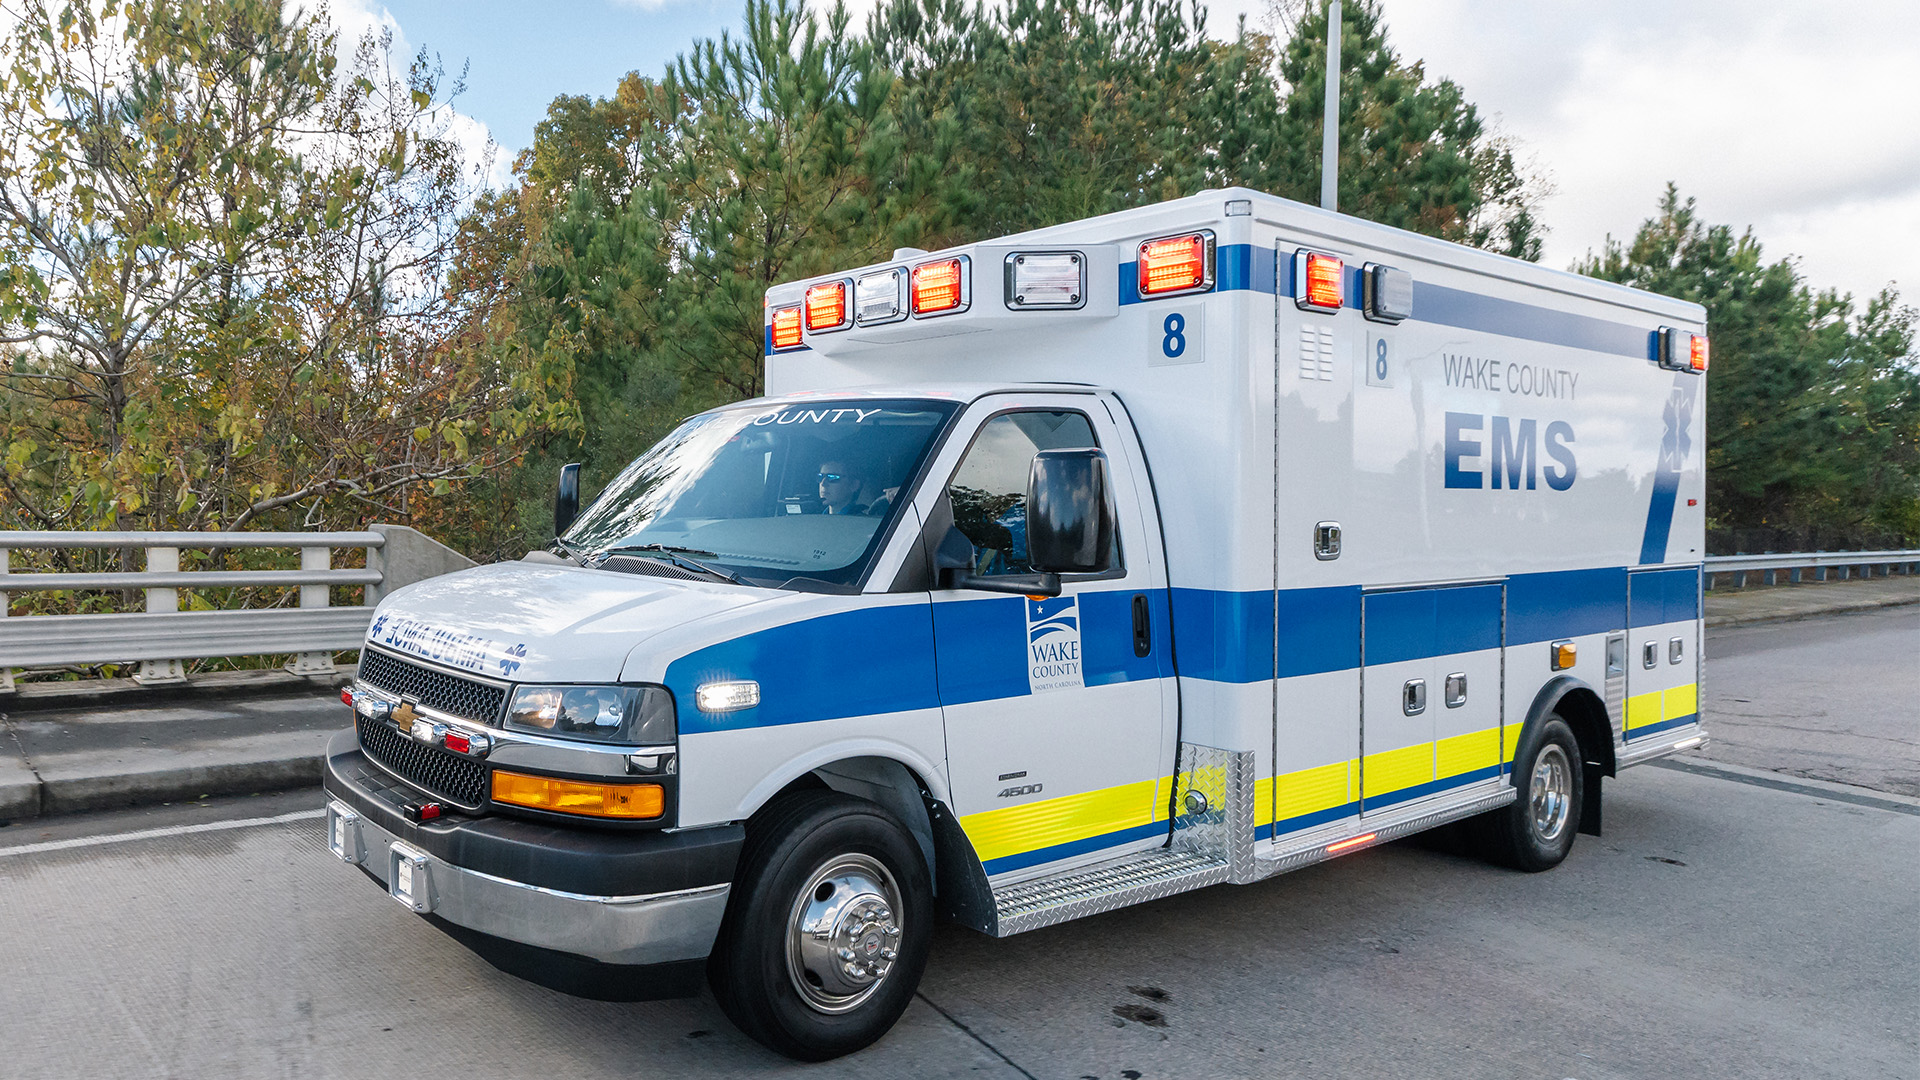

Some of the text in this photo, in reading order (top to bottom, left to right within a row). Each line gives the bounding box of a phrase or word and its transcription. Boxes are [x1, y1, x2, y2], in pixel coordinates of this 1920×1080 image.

[1162, 312, 1187, 359] 8
[1375, 338, 1388, 381] 8
[1443, 353, 1579, 401] WAKE COUNTY
[1444, 411, 1577, 492] EMS
[1031, 640, 1079, 663] WAKE
[1032, 662, 1079, 679] COUNTY
[1034, 680, 1082, 691] NORTH CAROLINA
[997, 783, 1043, 798] 4500
